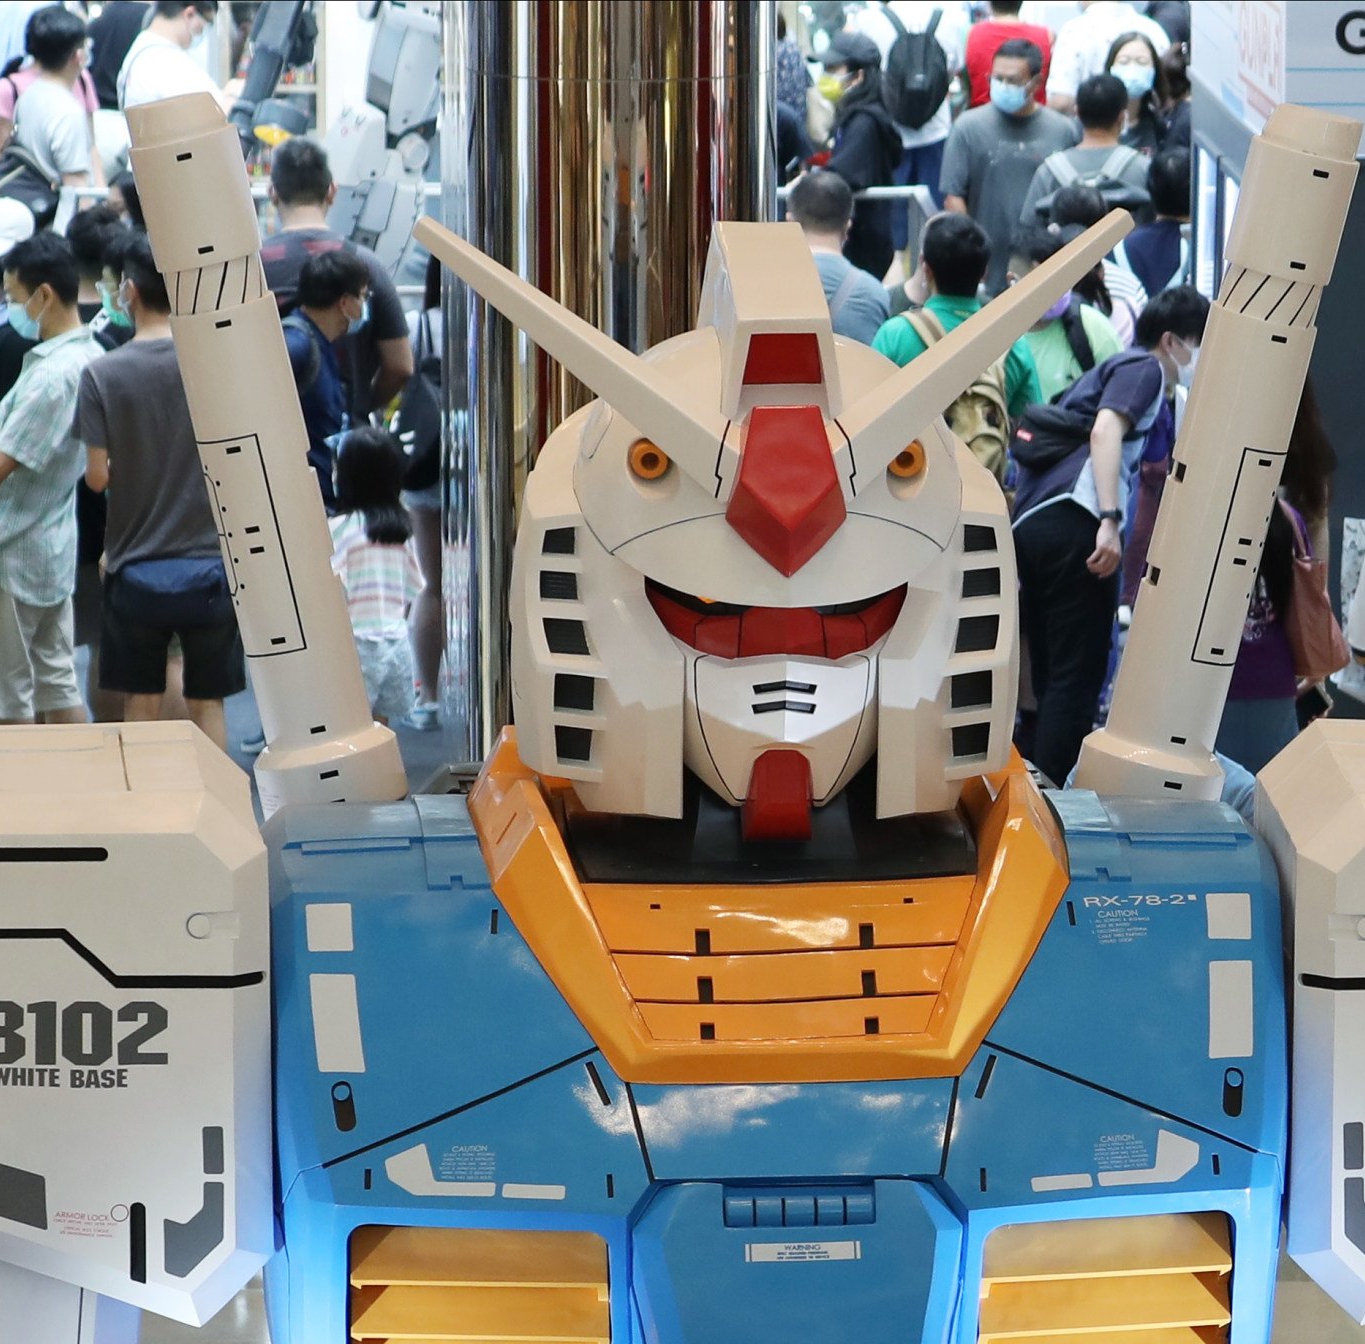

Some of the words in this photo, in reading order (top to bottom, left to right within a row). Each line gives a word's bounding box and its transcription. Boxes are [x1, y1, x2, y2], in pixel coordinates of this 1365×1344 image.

[1083, 894, 1186, 908] RX-78-2
[1097, 909, 1138, 918] CAUTION
[69, 1068, 128, 1089] BASE
[1099, 1134, 1135, 1143] CAUTION
[451, 1144, 488, 1153] CAUTION
[55, 1211, 86, 1220] ARMOR
[87, 1214, 110, 1222] LOCK
